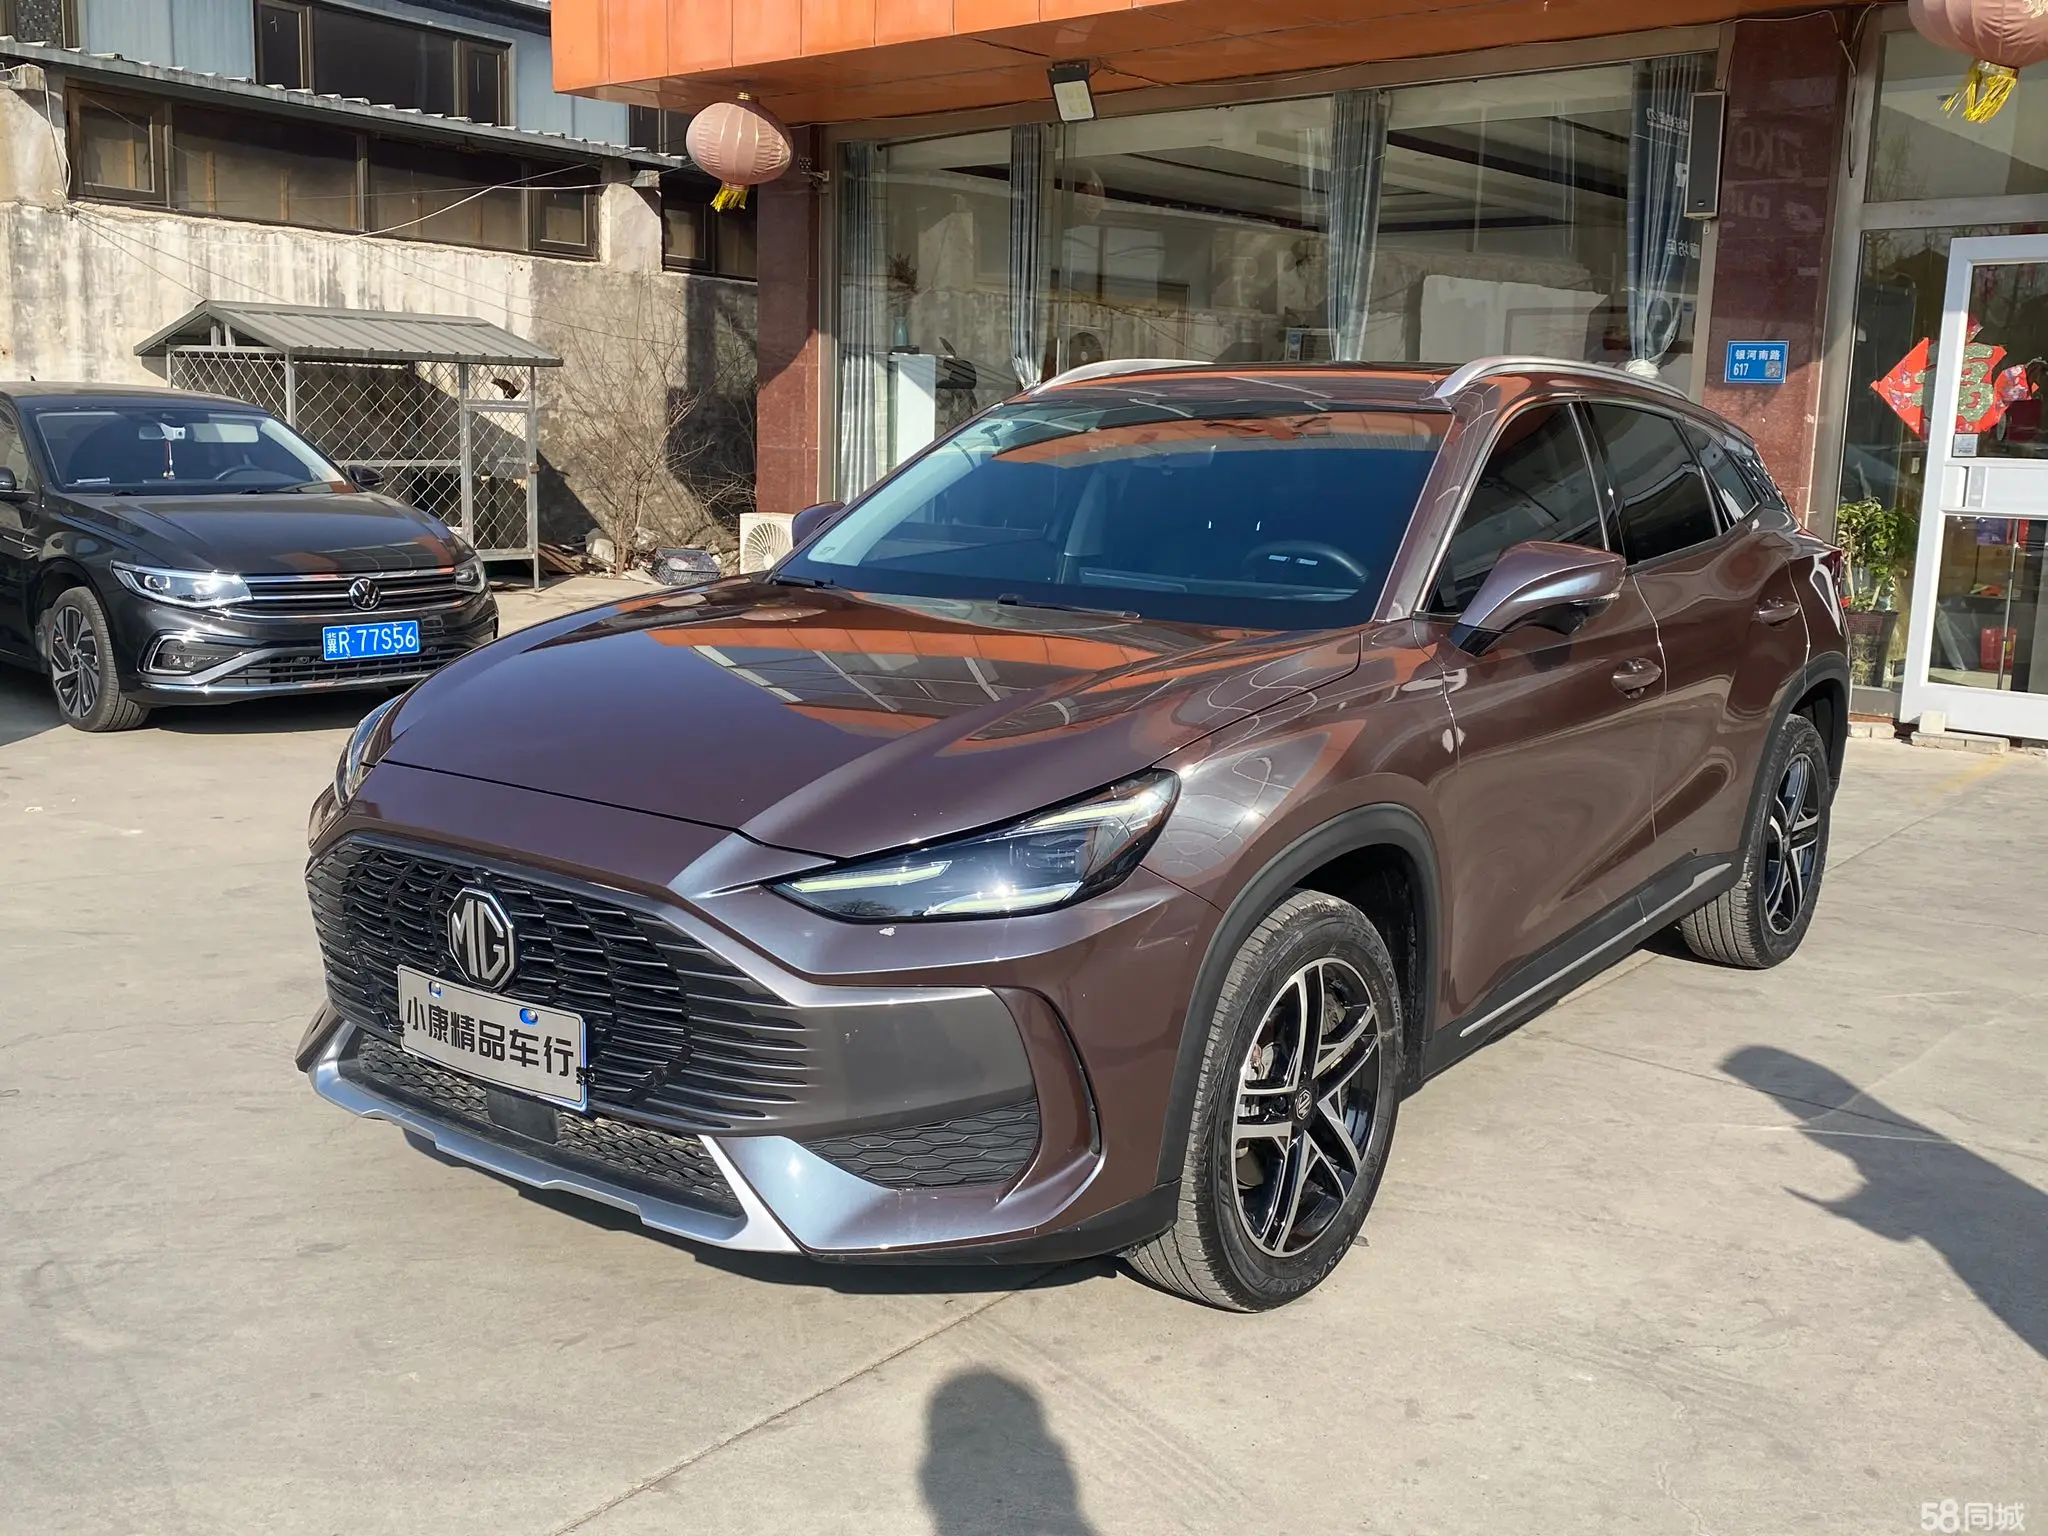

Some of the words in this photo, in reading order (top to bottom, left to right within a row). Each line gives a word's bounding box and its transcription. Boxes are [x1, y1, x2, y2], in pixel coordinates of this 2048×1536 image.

[1733, 363, 1749, 376] 617
[1735, 349, 1781, 361] 银河南路
[451, 898, 505, 982] MG
[406, 996, 575, 1078] 小康精品车行
